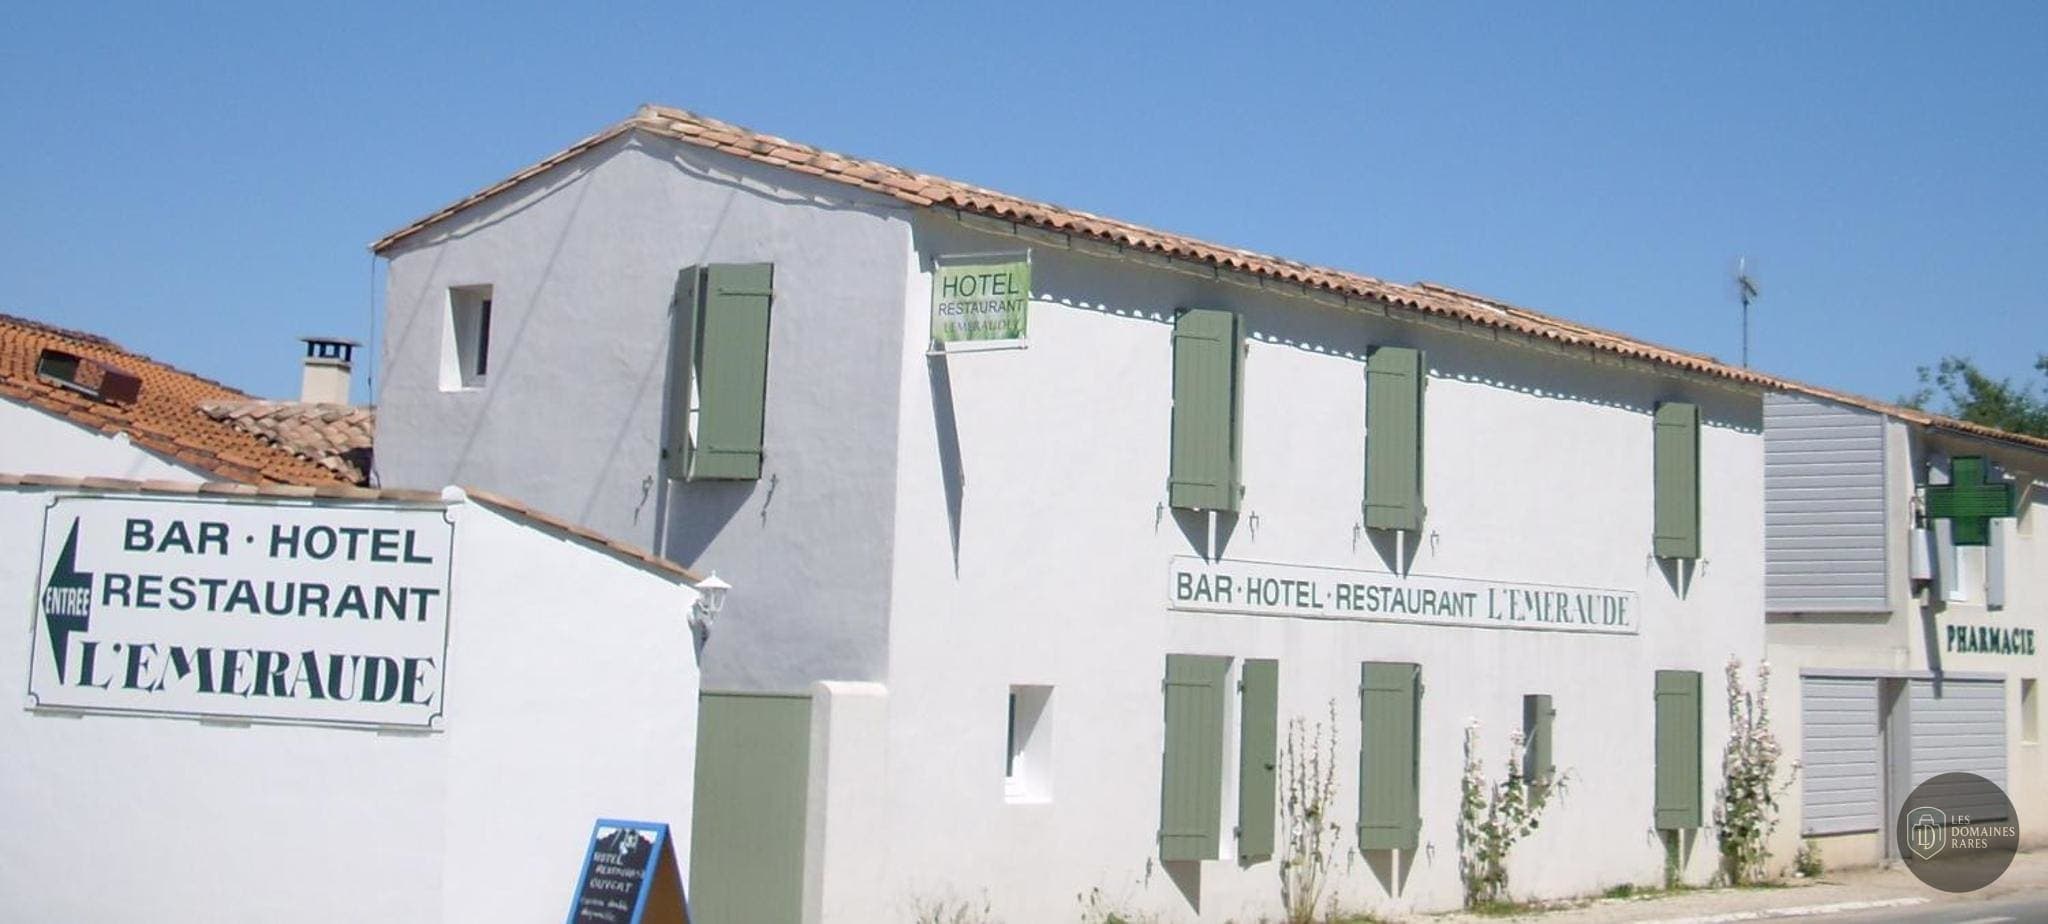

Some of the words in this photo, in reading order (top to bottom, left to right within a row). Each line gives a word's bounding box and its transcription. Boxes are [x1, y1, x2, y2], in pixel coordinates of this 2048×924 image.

[942, 272, 1019, 298] HOTEL
[938, 299, 1024, 316] RESTAURANT
[123, 518, 230, 555] BAR
[268, 525, 434, 564] HOTEL
[45, 586, 90, 616] ENTREE
[101, 573, 440, 622] RESTAURANT
[1176, 572, 1233, 604] BAR
[1246, 576, 1324, 609] HOTEL
[1335, 583, 1478, 618] RESTAURANT
[1487, 587, 1630, 627] L'EMERAUDE
[1946, 624, 2036, 656] PHARMACIE
[75, 640, 437, 707] L'EMERAUDE
